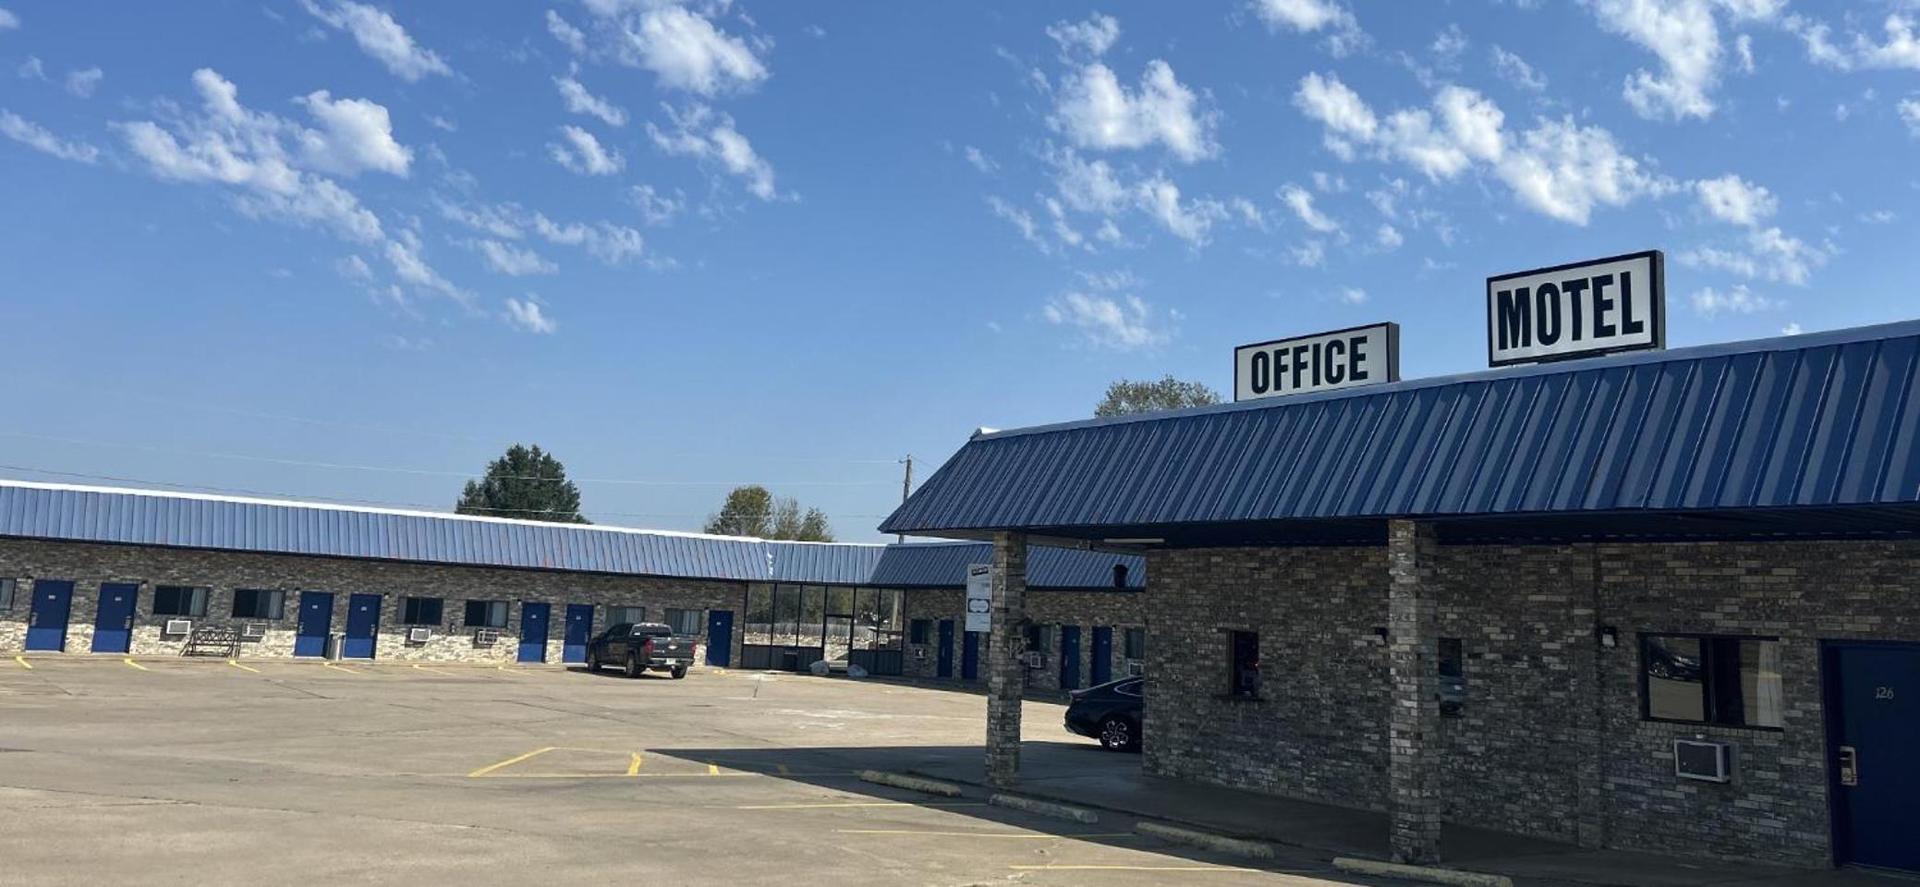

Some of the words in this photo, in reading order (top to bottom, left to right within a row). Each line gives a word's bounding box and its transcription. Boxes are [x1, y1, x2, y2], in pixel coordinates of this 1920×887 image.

[1496, 270, 1644, 350] MOTEL
[1250, 336, 1368, 394] OFFICE
[1875, 686, 1895, 700] 126
